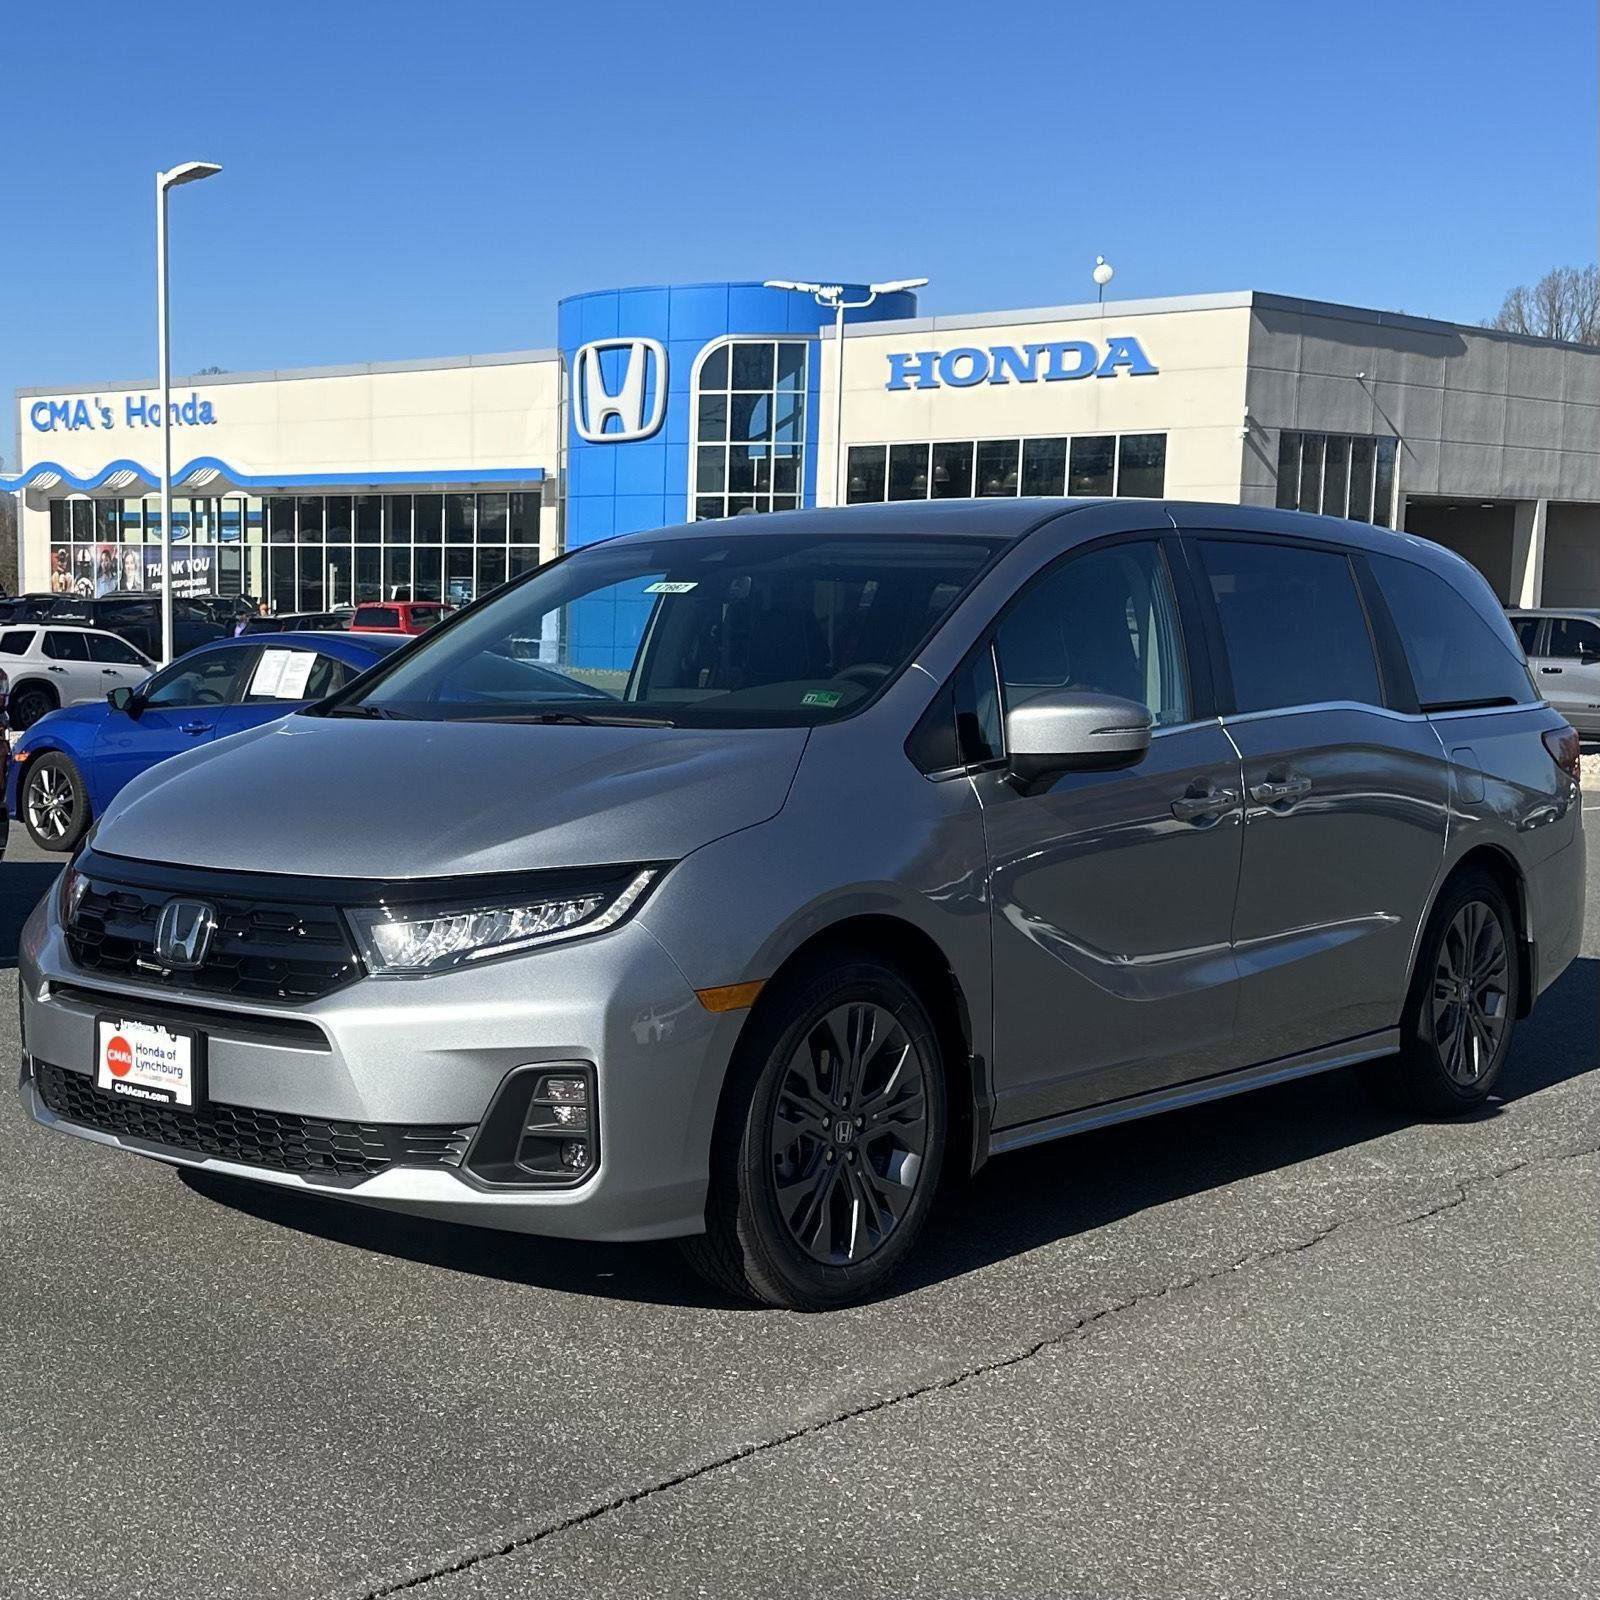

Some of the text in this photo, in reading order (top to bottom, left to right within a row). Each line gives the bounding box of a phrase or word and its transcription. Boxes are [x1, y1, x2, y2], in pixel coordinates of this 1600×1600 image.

[885, 337, 1159, 391] HONDA
[30, 397, 114, 432] CMA's
[146, 557, 210, 577] THNK YOU
[135, 1043, 176, 1061] Honda of
[135, 1057, 184, 1079] Lynchburg
[114, 1083, 170, 1103] CMAcars.com
